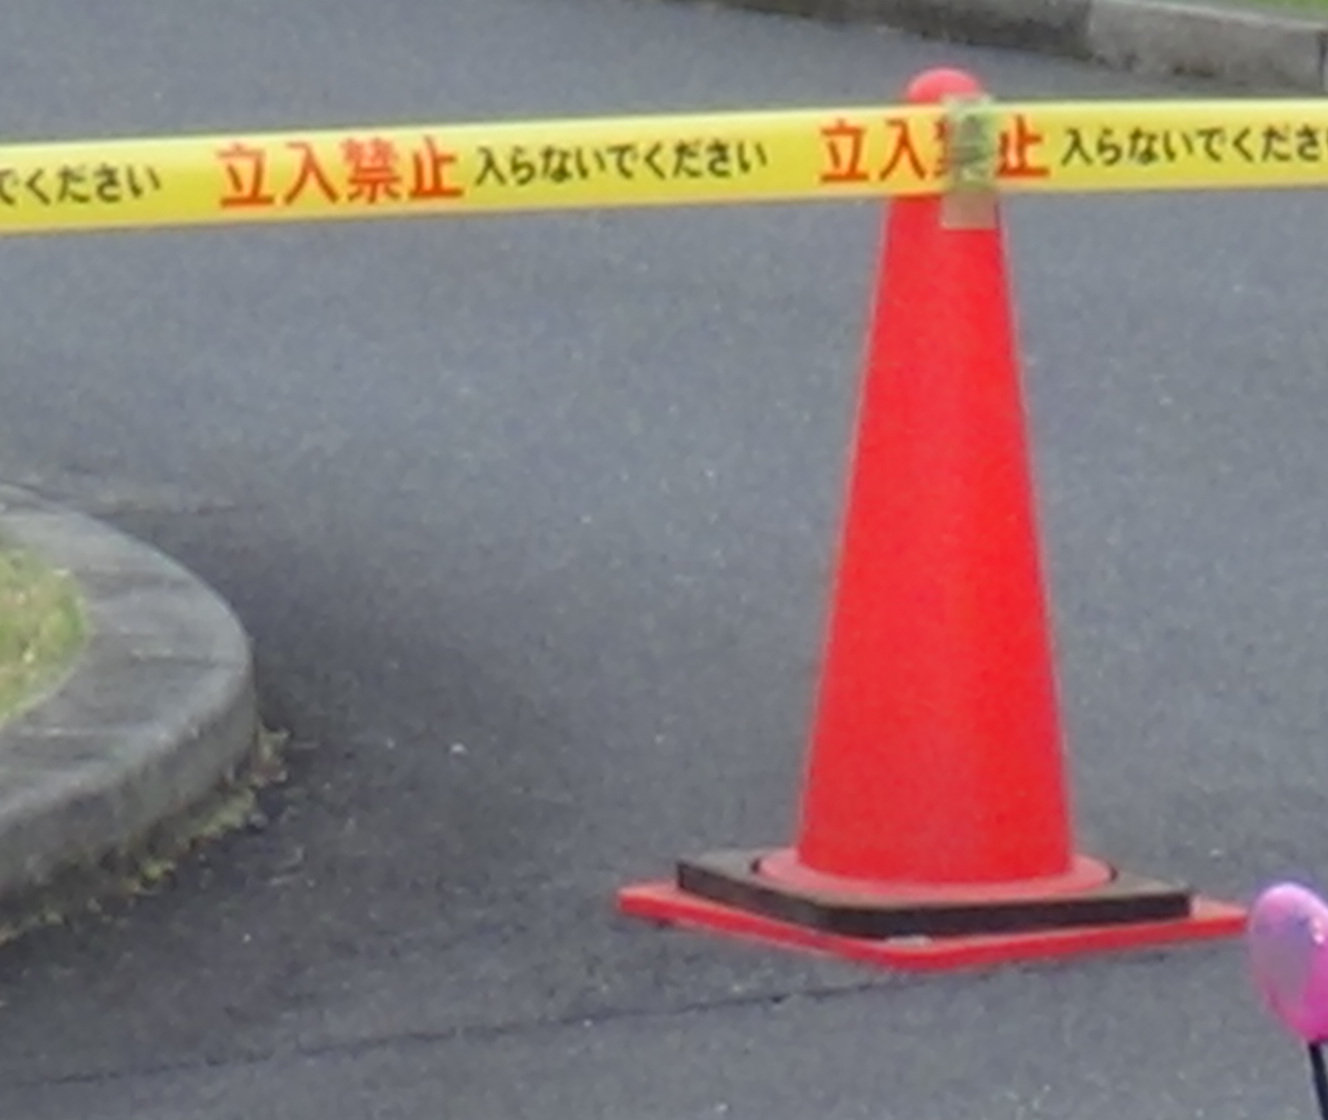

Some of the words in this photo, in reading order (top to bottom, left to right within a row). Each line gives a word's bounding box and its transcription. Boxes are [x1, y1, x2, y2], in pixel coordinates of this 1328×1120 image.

[216, 135, 465, 209] 立入禁止
[475, 139, 767, 187] 入らないでください
